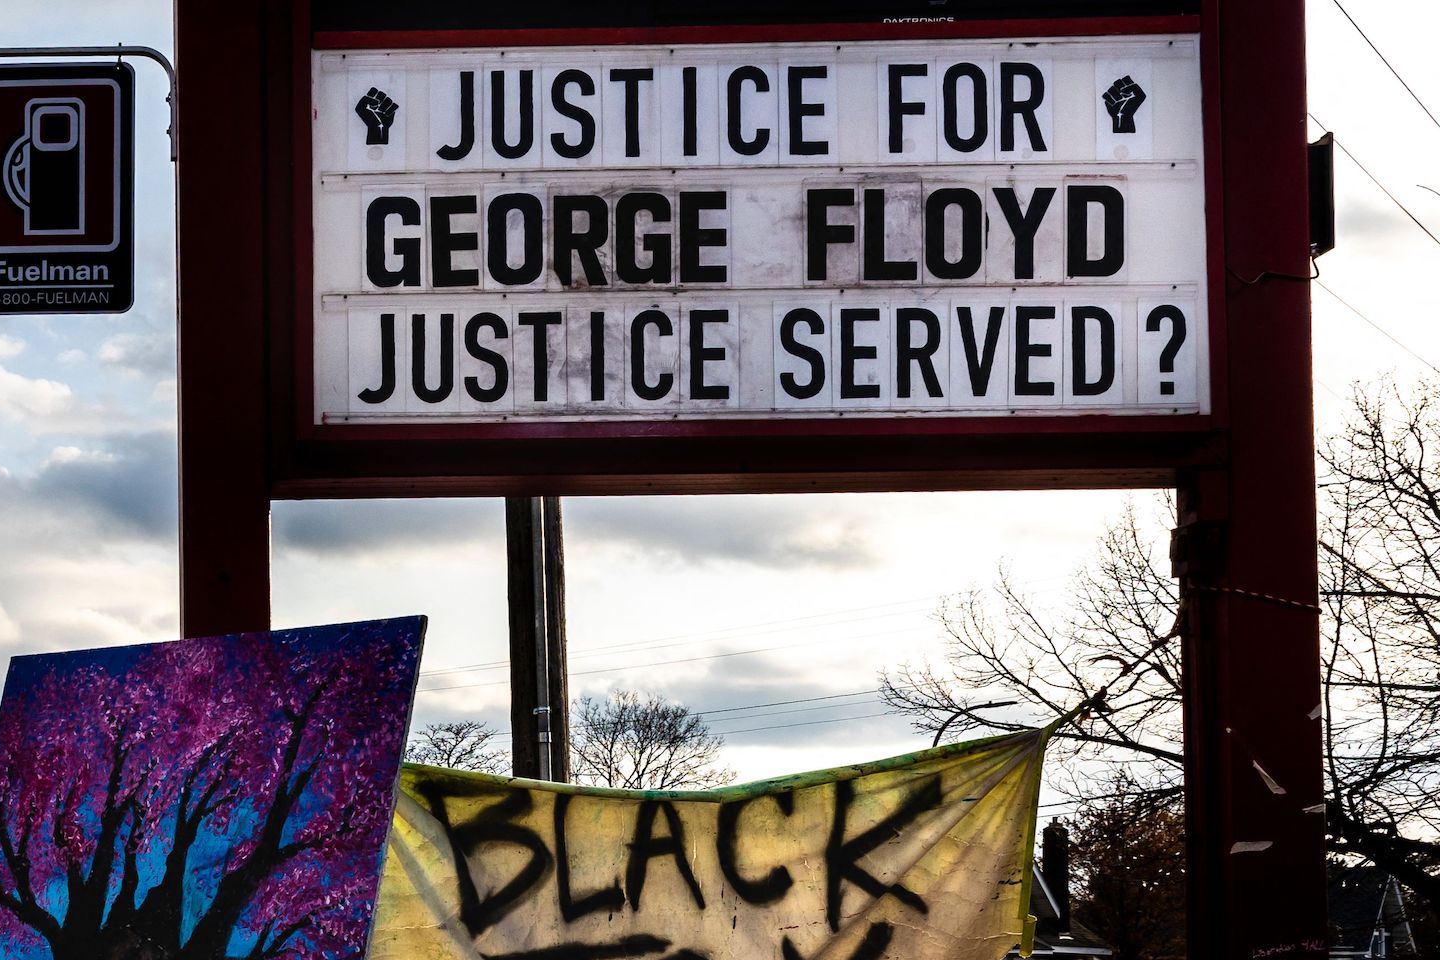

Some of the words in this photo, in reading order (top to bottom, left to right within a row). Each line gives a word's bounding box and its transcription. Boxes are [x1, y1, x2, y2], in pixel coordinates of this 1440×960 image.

[436, 65, 829, 161] JUSTICE
[887, 61, 1048, 154] FOR
[365, 191, 728, 288] GEORGE
[806, 185, 1125, 281] FLOYD
[357, 309, 730, 404] JUSTICE
[415, 775, 942, 937] BLACK
